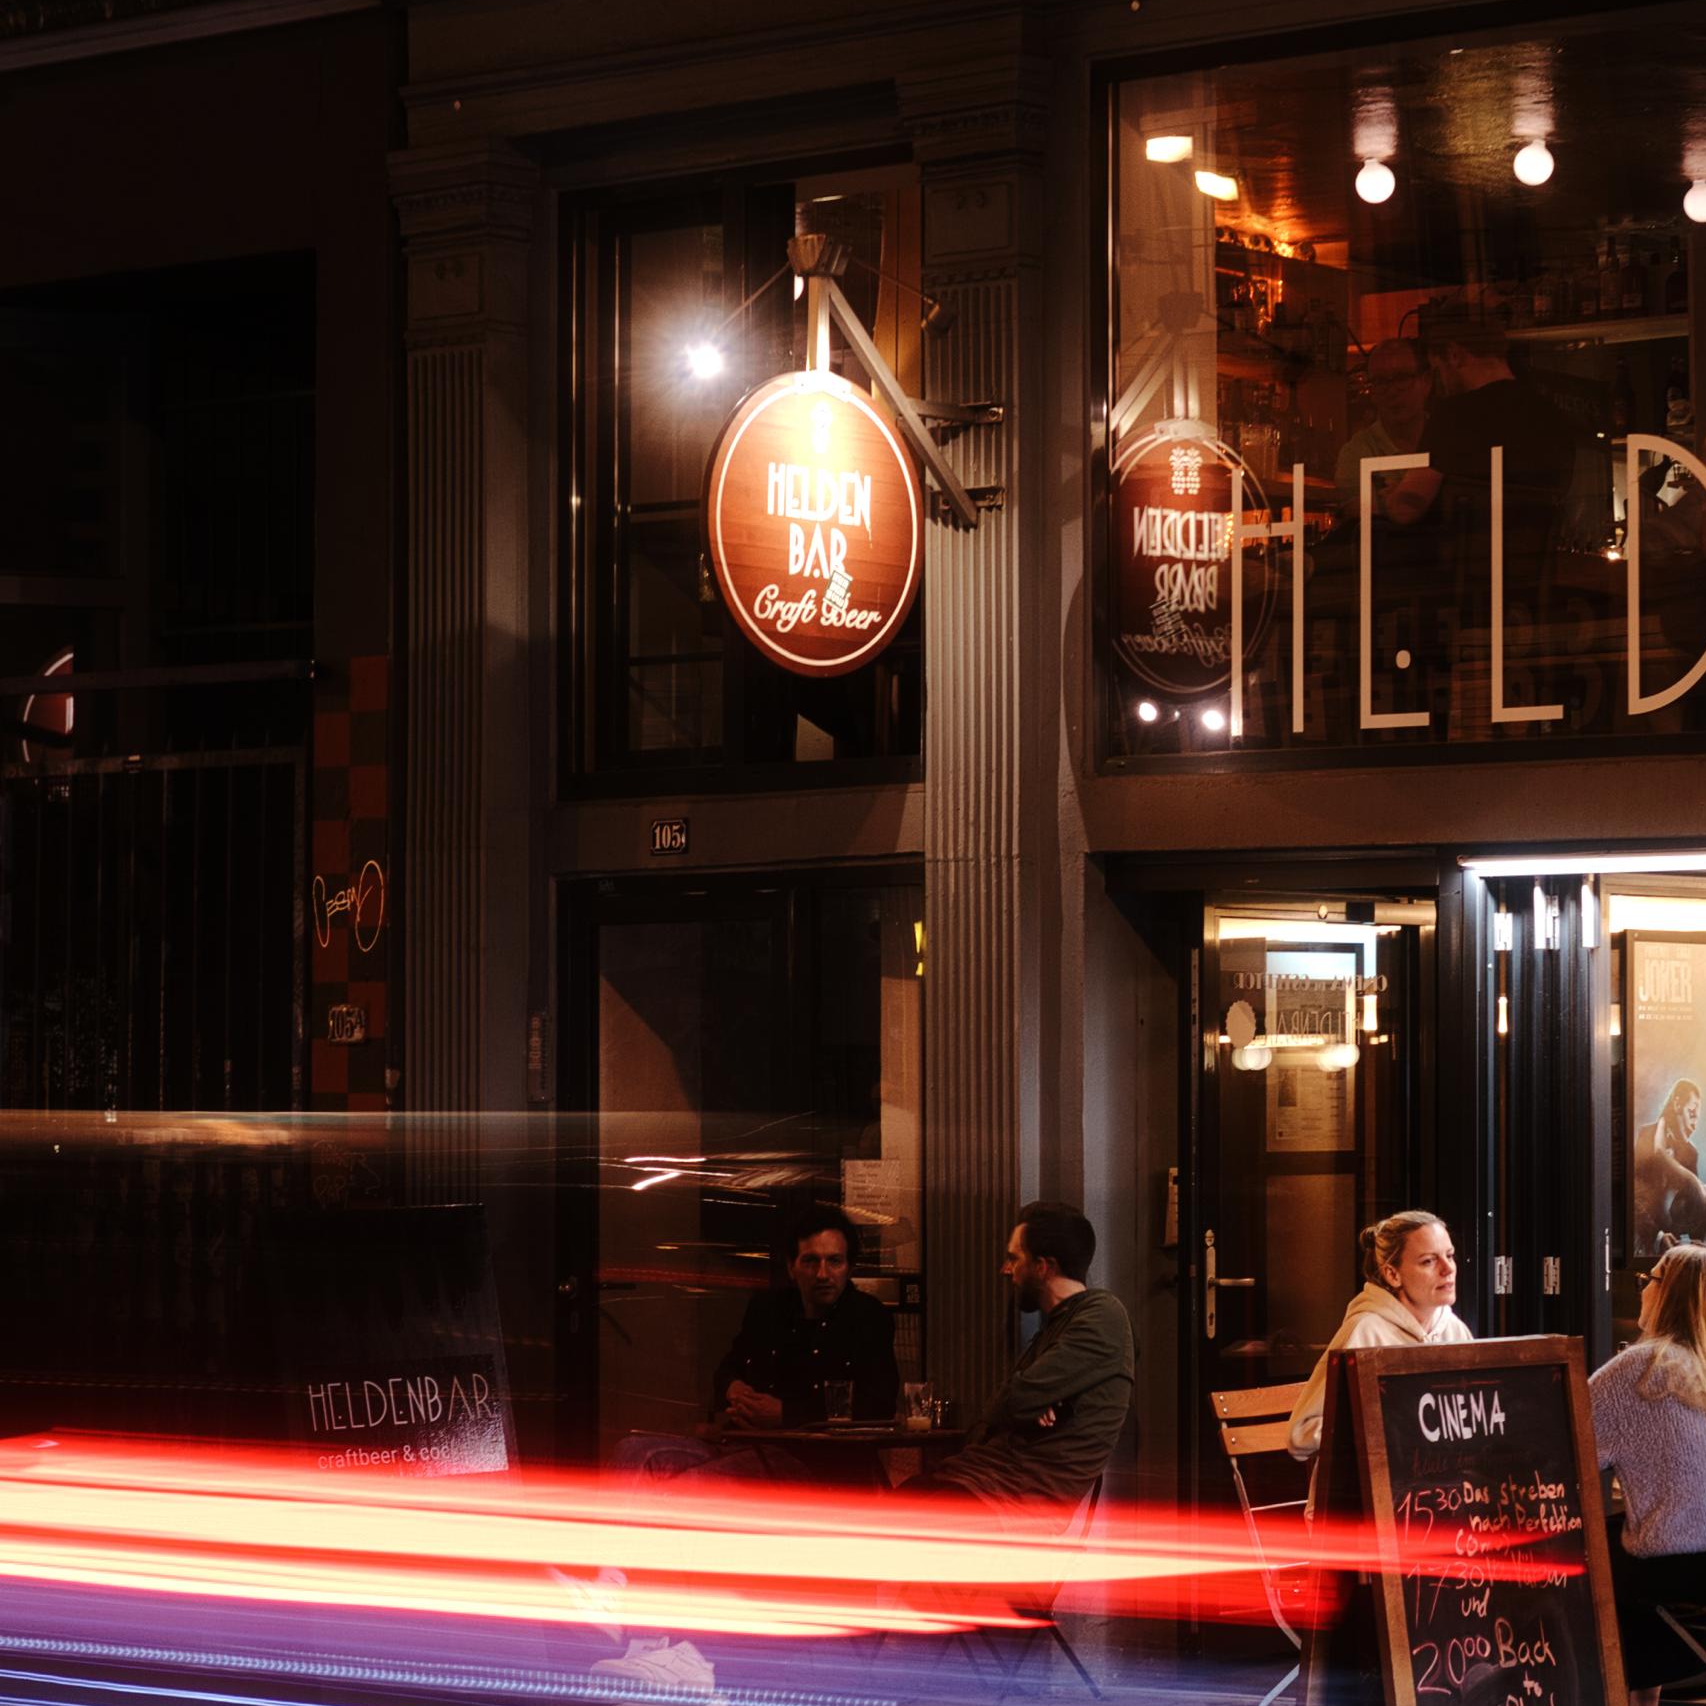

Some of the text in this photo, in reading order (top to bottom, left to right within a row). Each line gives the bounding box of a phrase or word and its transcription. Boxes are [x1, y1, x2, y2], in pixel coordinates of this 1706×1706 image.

[767, 462, 872, 533] HELDEN
[788, 522, 853, 581] BAR
[754, 583, 817, 633] Craft
[820, 592, 882, 630] Beer
[1639, 959, 1693, 1004] JOKER
[307, 1372, 497, 1433] HELDENBAR
[1418, 1389, 1506, 1443] CINEMA
[317, 1446, 398, 1470] craftbeer
[403, 1444, 416, 1463] &
[1461, 1587, 1490, 1617] und
[1494, 1615, 1557, 1669] Back
[1523, 1669, 1543, 1697] to
